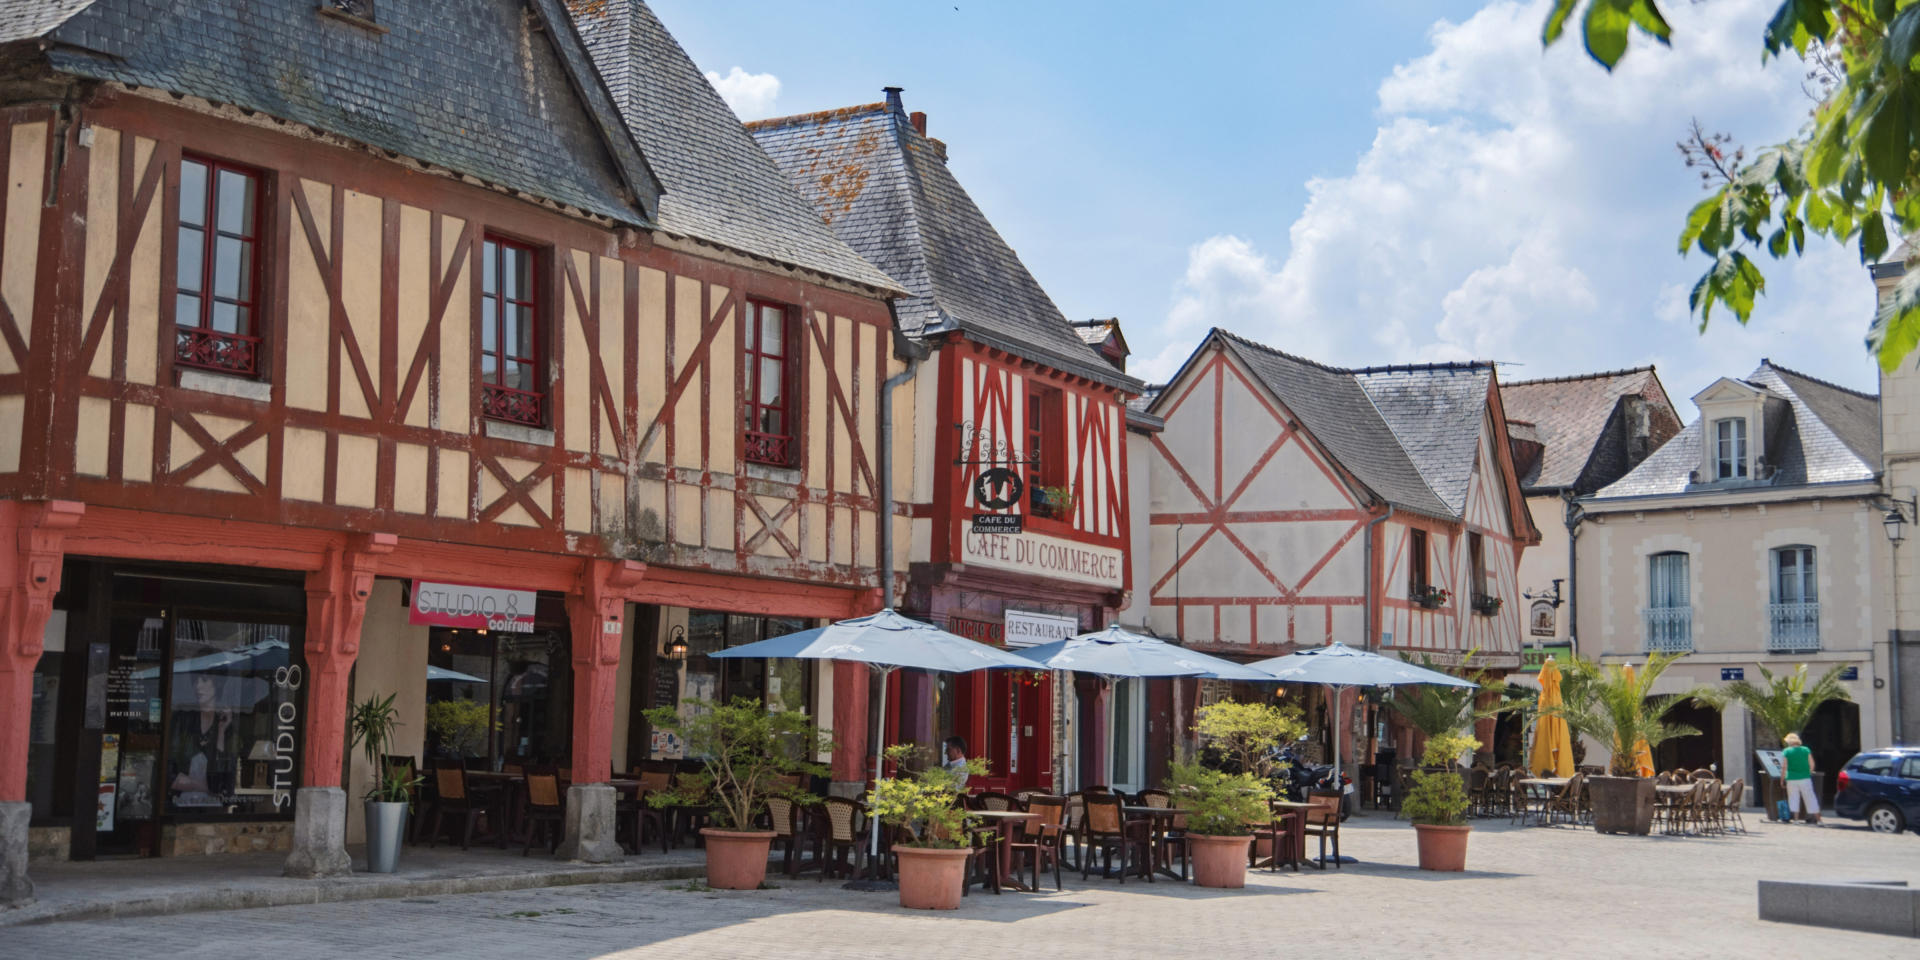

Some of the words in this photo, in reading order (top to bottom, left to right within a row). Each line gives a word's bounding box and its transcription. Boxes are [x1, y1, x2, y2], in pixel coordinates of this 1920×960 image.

[966, 528, 1010, 560] CAFE
[1016, 538, 1035, 564] DU
[1039, 543, 1117, 579] COMMERCE
[418, 590, 496, 618] STUDIO
[505, 592, 519, 621] 8
[489, 619, 535, 633] COIFFURE
[1008, 620, 1075, 638] RESTAURANT
[275, 664, 302, 690] 8
[273, 702, 297, 808] STUDIO
